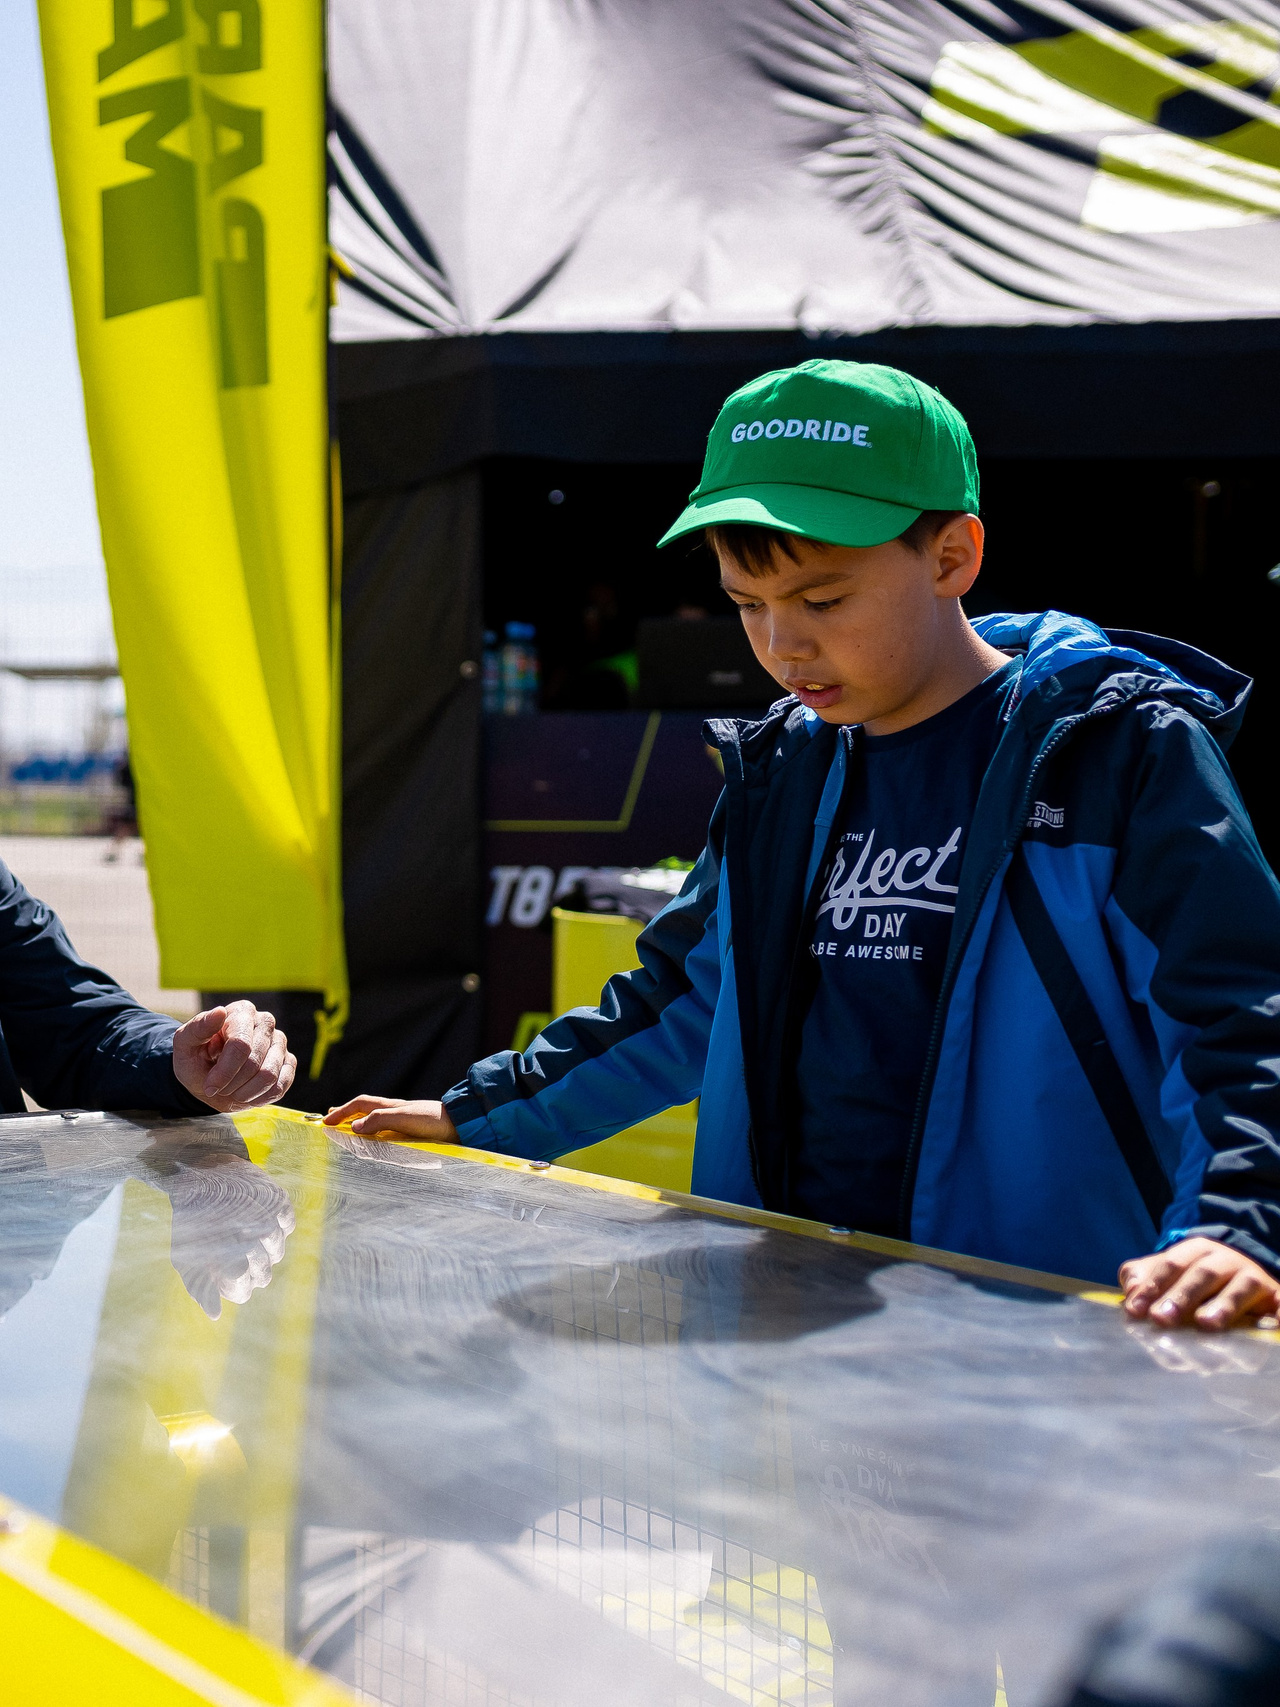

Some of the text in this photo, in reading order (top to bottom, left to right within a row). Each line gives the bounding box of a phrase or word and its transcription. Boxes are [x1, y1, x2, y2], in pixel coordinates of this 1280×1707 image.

[731, 418, 870, 447] GOODRIDE
[1034, 805, 1065, 824] STRONG
[846, 832, 864, 842] THE
[863, 912, 908, 938] DAY
[817, 941, 838, 956] BE
[844, 944, 924, 961] AWESOME
